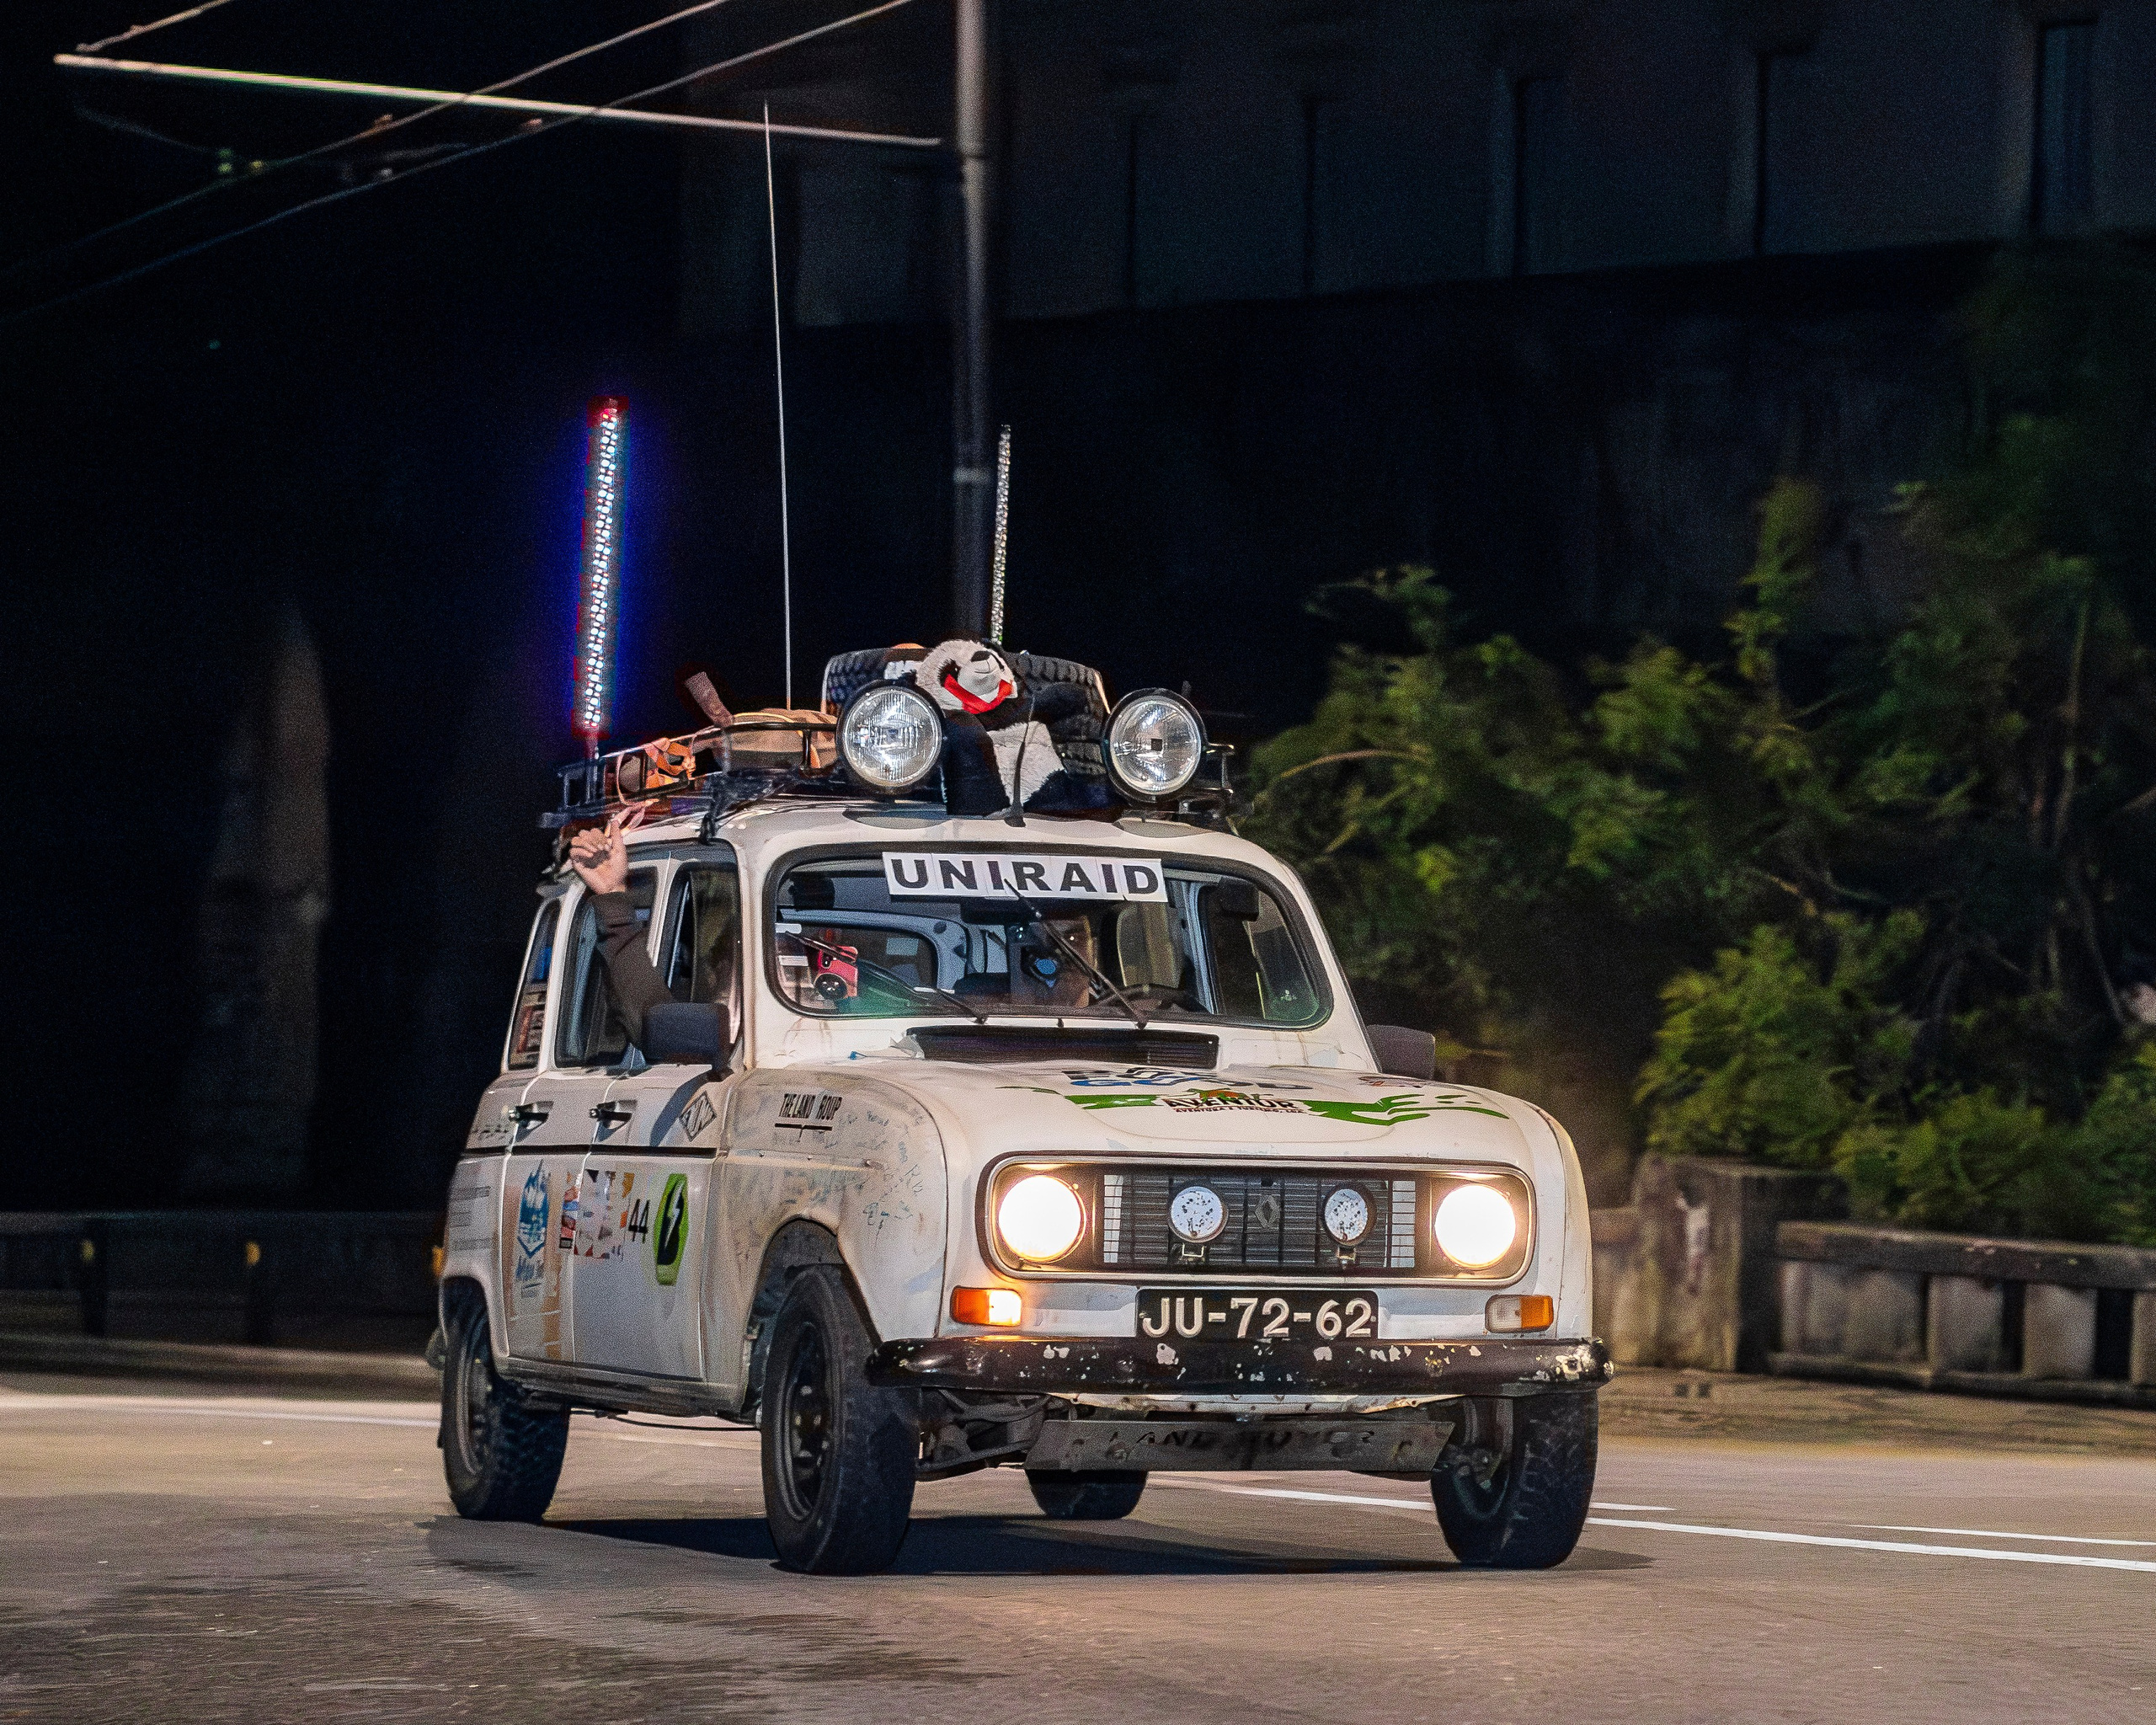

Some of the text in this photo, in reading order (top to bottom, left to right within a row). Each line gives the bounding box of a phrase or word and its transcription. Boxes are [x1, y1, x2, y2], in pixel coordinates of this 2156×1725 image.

[890, 858, 1159, 895] UNIRAID
[628, 1199, 650, 1244] 44
[1142, 1297, 1372, 1338] JU-72-62
